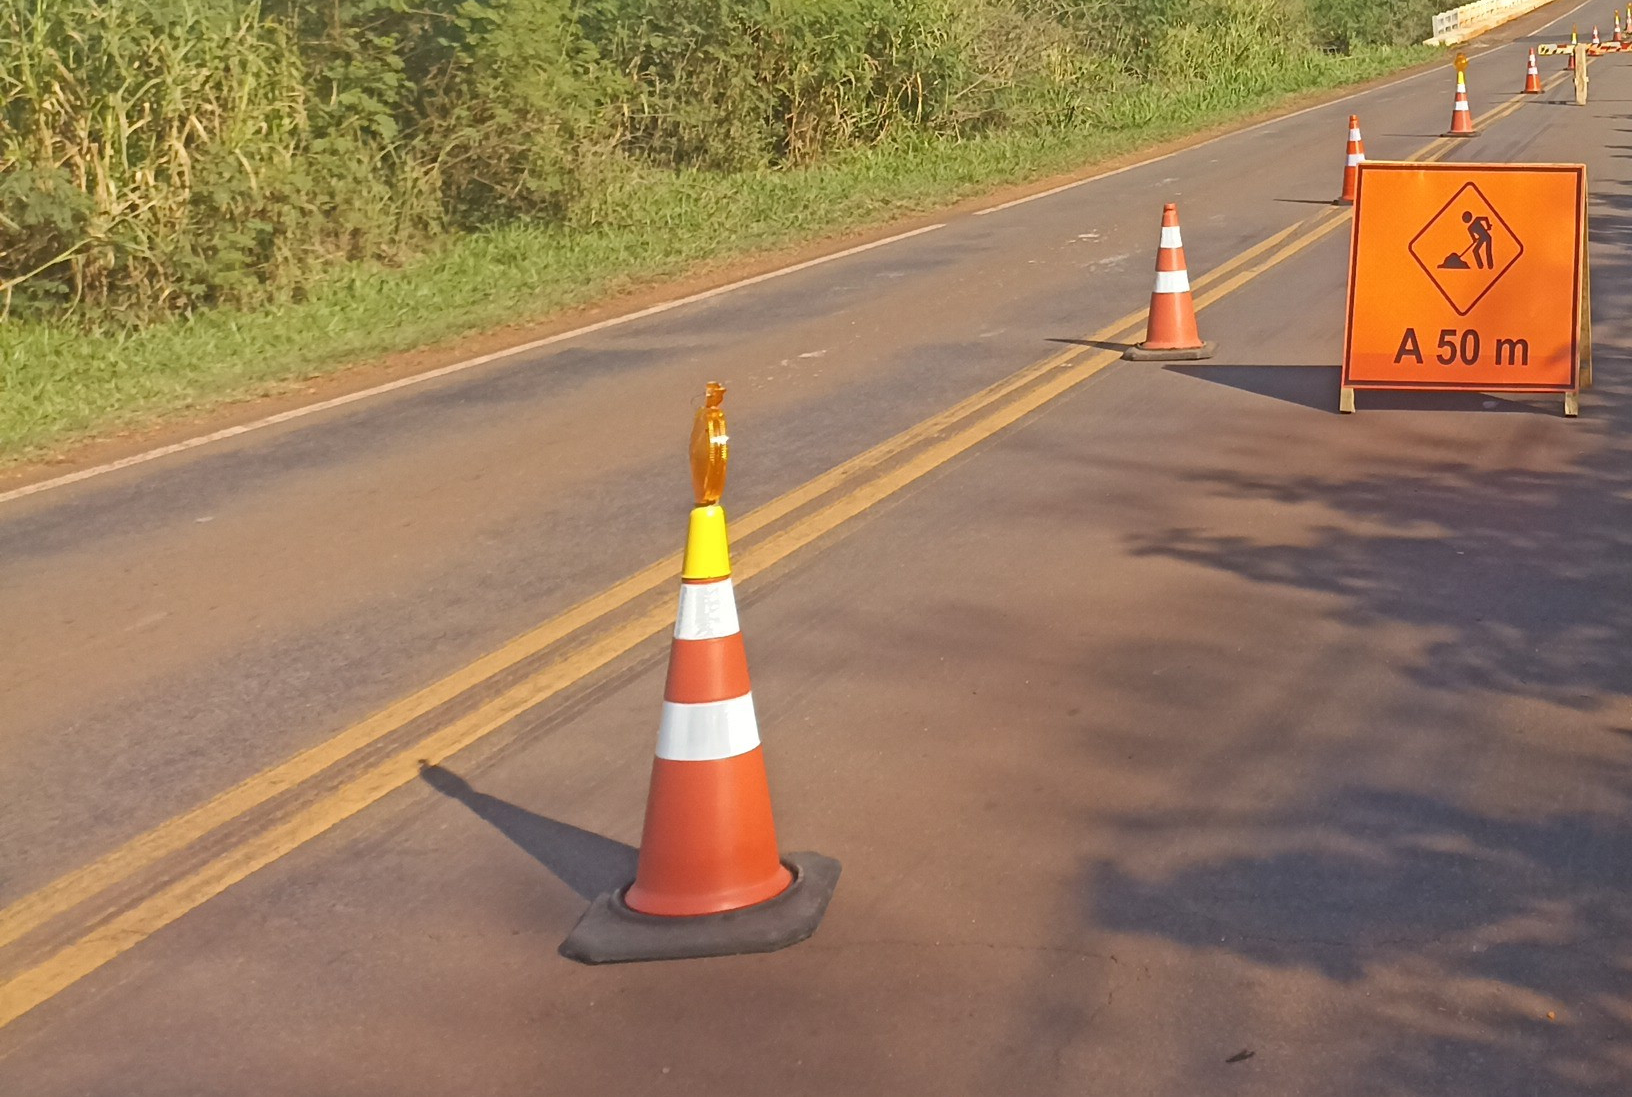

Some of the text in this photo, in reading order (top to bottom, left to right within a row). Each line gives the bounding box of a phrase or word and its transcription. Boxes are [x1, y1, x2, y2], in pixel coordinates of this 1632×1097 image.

[1393, 327, 1529, 366] A 50 m
